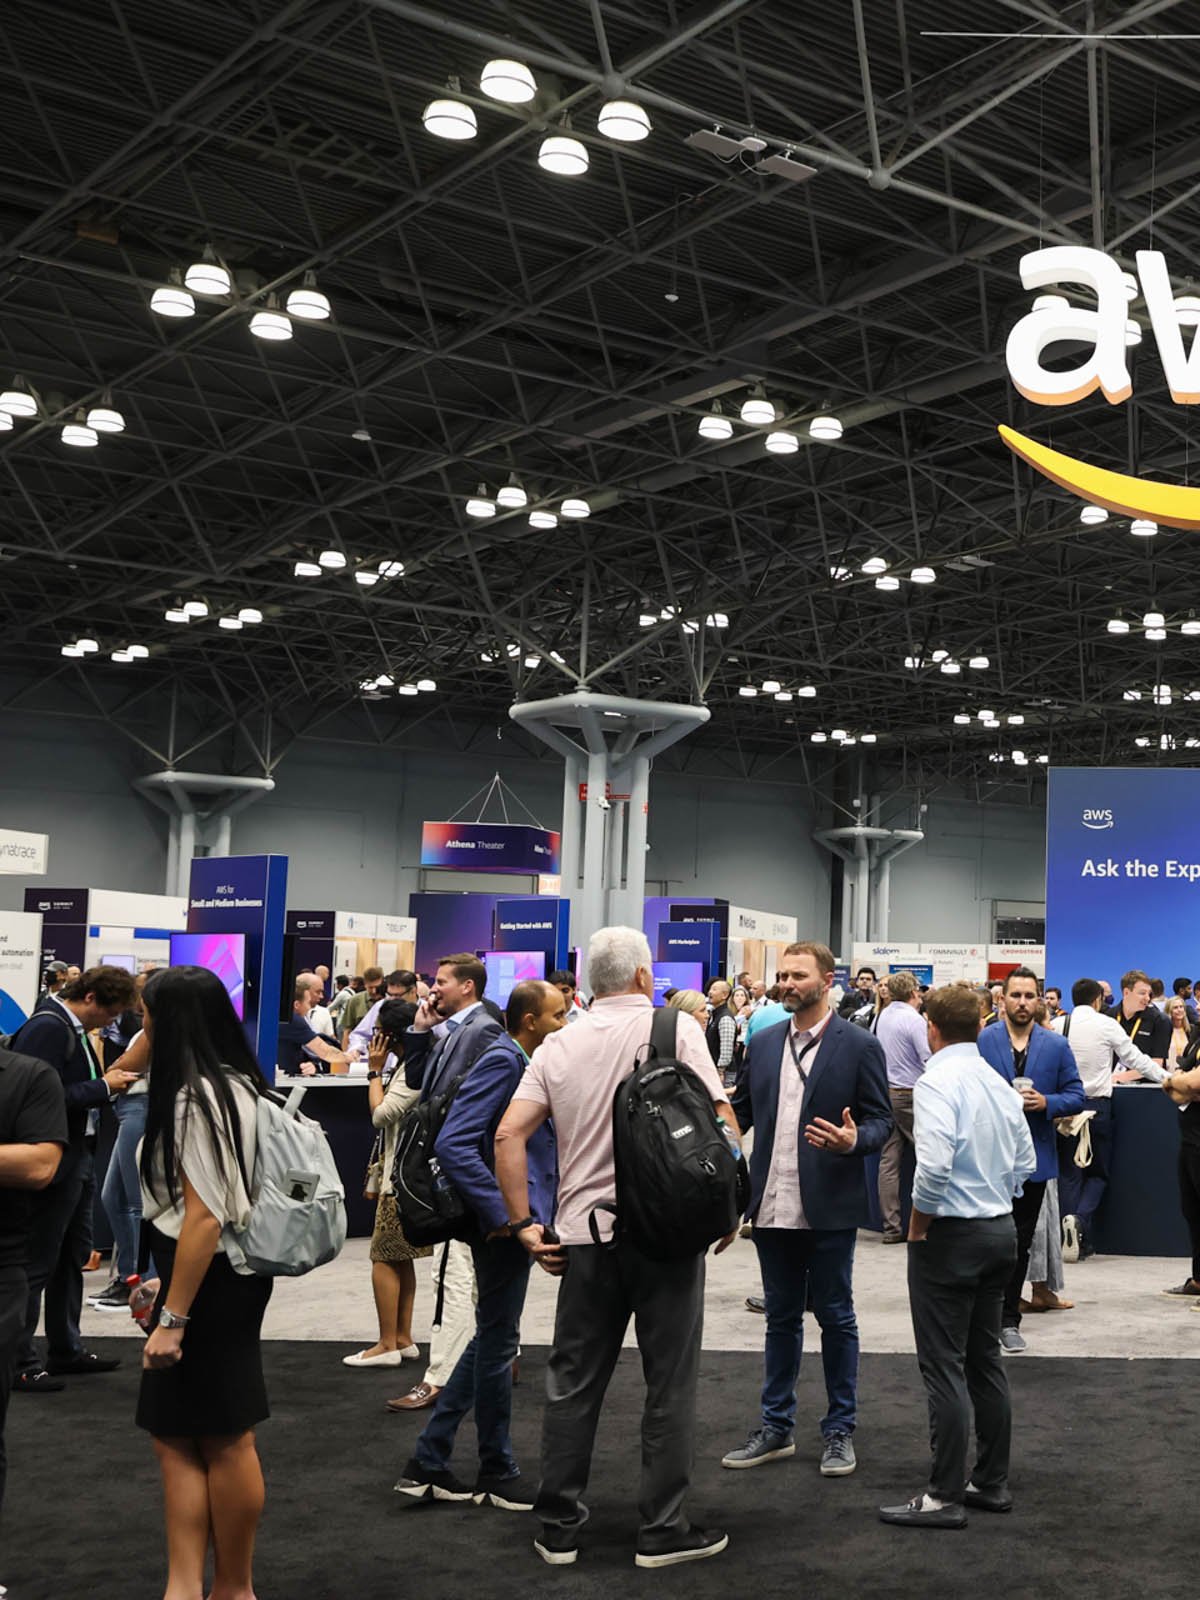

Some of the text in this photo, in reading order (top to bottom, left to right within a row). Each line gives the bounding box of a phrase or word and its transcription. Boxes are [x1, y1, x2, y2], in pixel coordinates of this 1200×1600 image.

[1082, 809, 1113, 821] aws
[446, 840, 504, 850] Athena Theater
[1081, 859, 1119, 878] Ask
[1125, 859, 1159, 878] the
